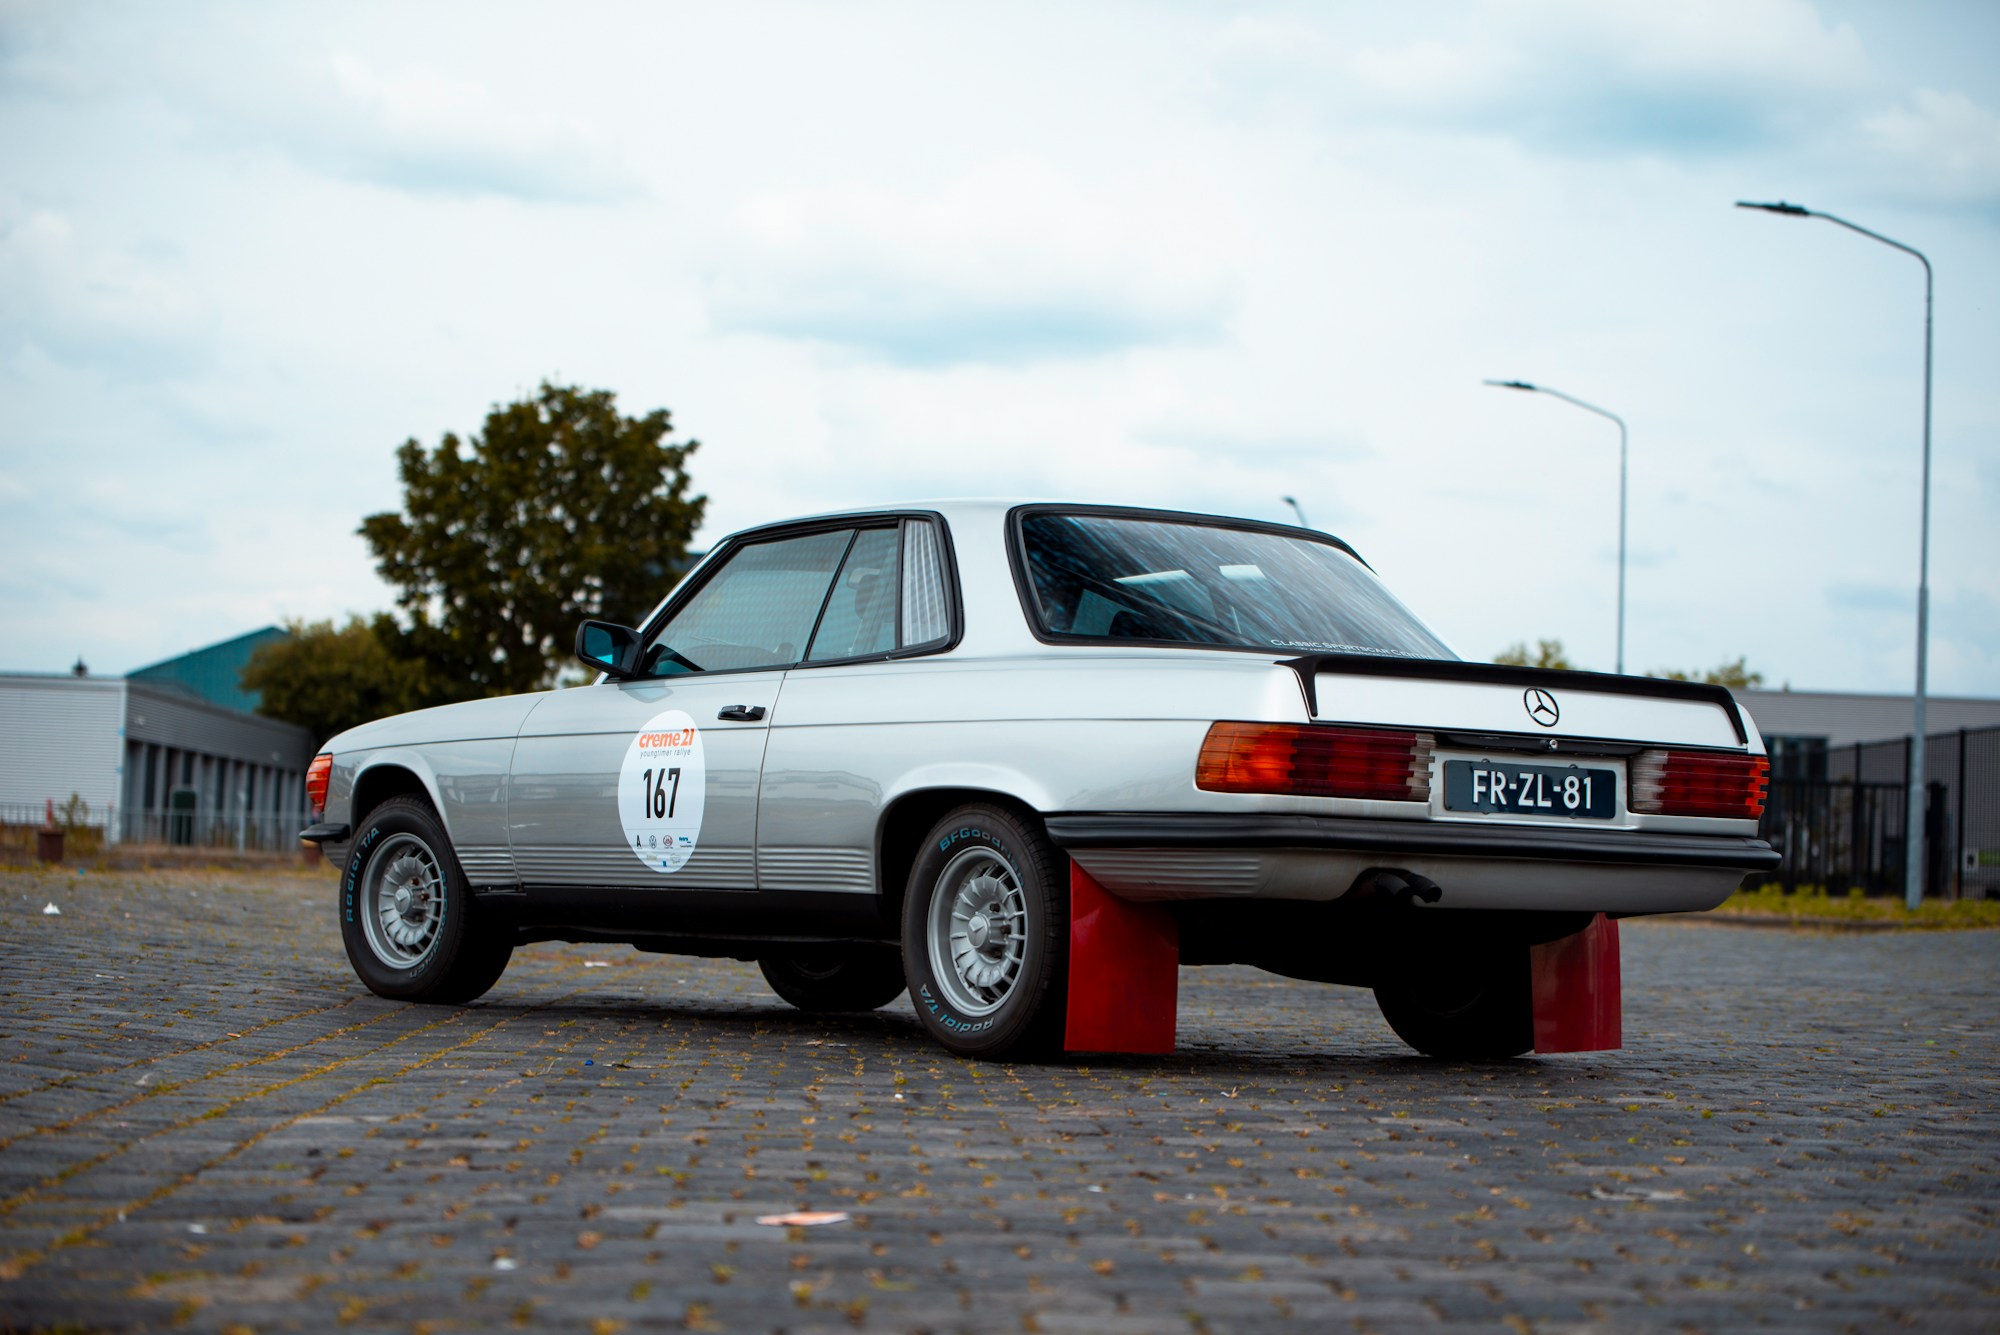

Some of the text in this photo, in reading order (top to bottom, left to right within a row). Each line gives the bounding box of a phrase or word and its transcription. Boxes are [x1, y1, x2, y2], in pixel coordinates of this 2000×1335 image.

[1270, 639, 1322, 649] CLASSIC
[640, 748, 691, 760] youngtimer rallye
[643, 768, 681, 819] 167
[1472, 769, 1592, 810] FR-ZL-81
[346, 827, 380, 923] Radial T/A
[938, 827, 1025, 888] BFGoodrich
[939, 1013, 995, 1033] Radial
